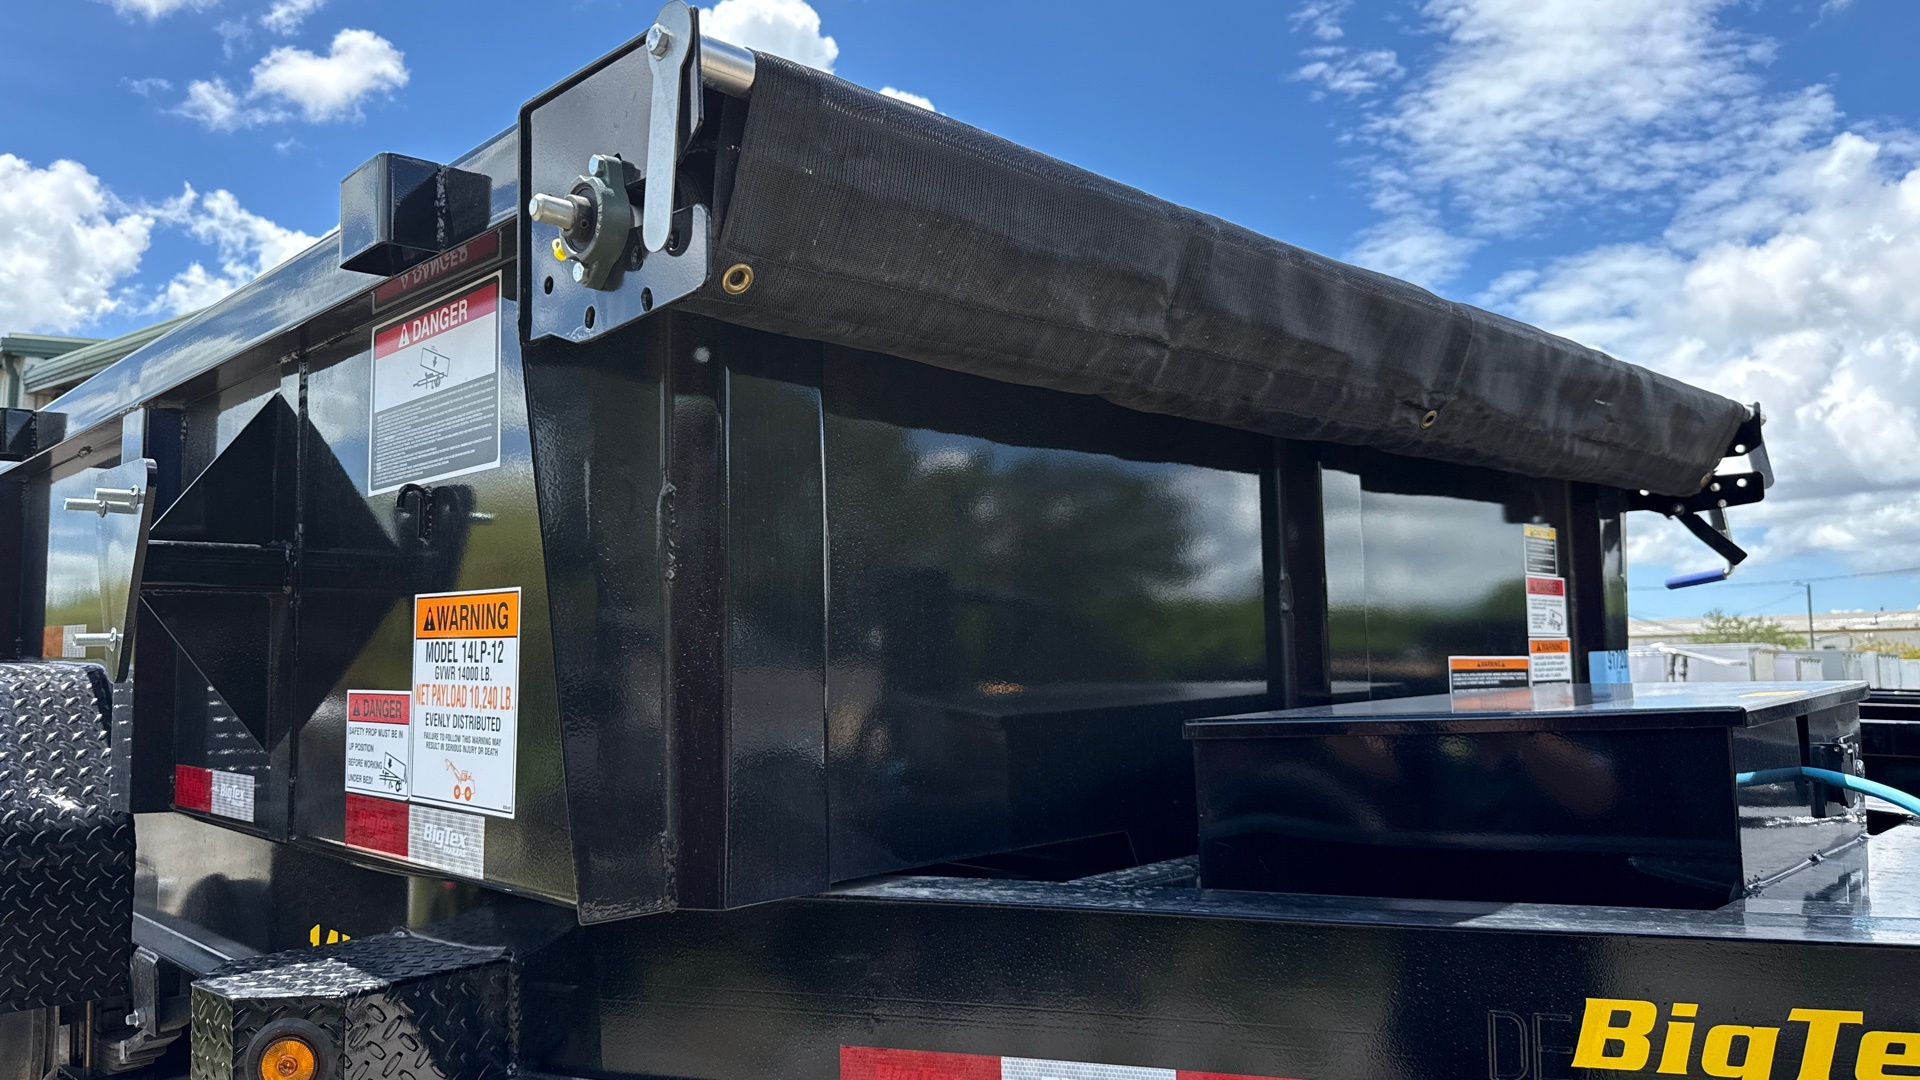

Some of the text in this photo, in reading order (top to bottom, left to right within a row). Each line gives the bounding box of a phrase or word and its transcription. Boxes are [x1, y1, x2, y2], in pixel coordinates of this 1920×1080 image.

[412, 299, 468, 342] DANGER
[1537, 581, 1559, 593] DANGER
[436, 601, 509, 631] WARNING
[425, 640, 504, 664] MODEL 14LP-12
[1541, 642, 1564, 651] WARNING
[435, 666, 492, 682] GVWR 14000 LB.
[416, 683, 514, 713] NET PAYLOAD 10,240 LB.
[363, 698, 402, 719] DANGER
[425, 712, 501, 732] EVENLY DISTRIBUTED
[349, 726, 403, 739] SAFETY PROP MUST BE IN
[424, 732, 502, 747] FAILURE TO FOLLOW THIS WARNING MAY
[348, 742, 374, 752] UP POSITION
[426, 741, 440, 750] RESULT
[445, 743, 462, 752] SERIOUS
[463, 744, 477, 754] INJURY
[484, 747, 499, 757] DEATH
[348, 758, 382, 770] BEFORE WORKING
[348, 773, 362, 783] UNDER
[220, 783, 245, 801] BigTex
[424, 823, 467, 848] BigTex
